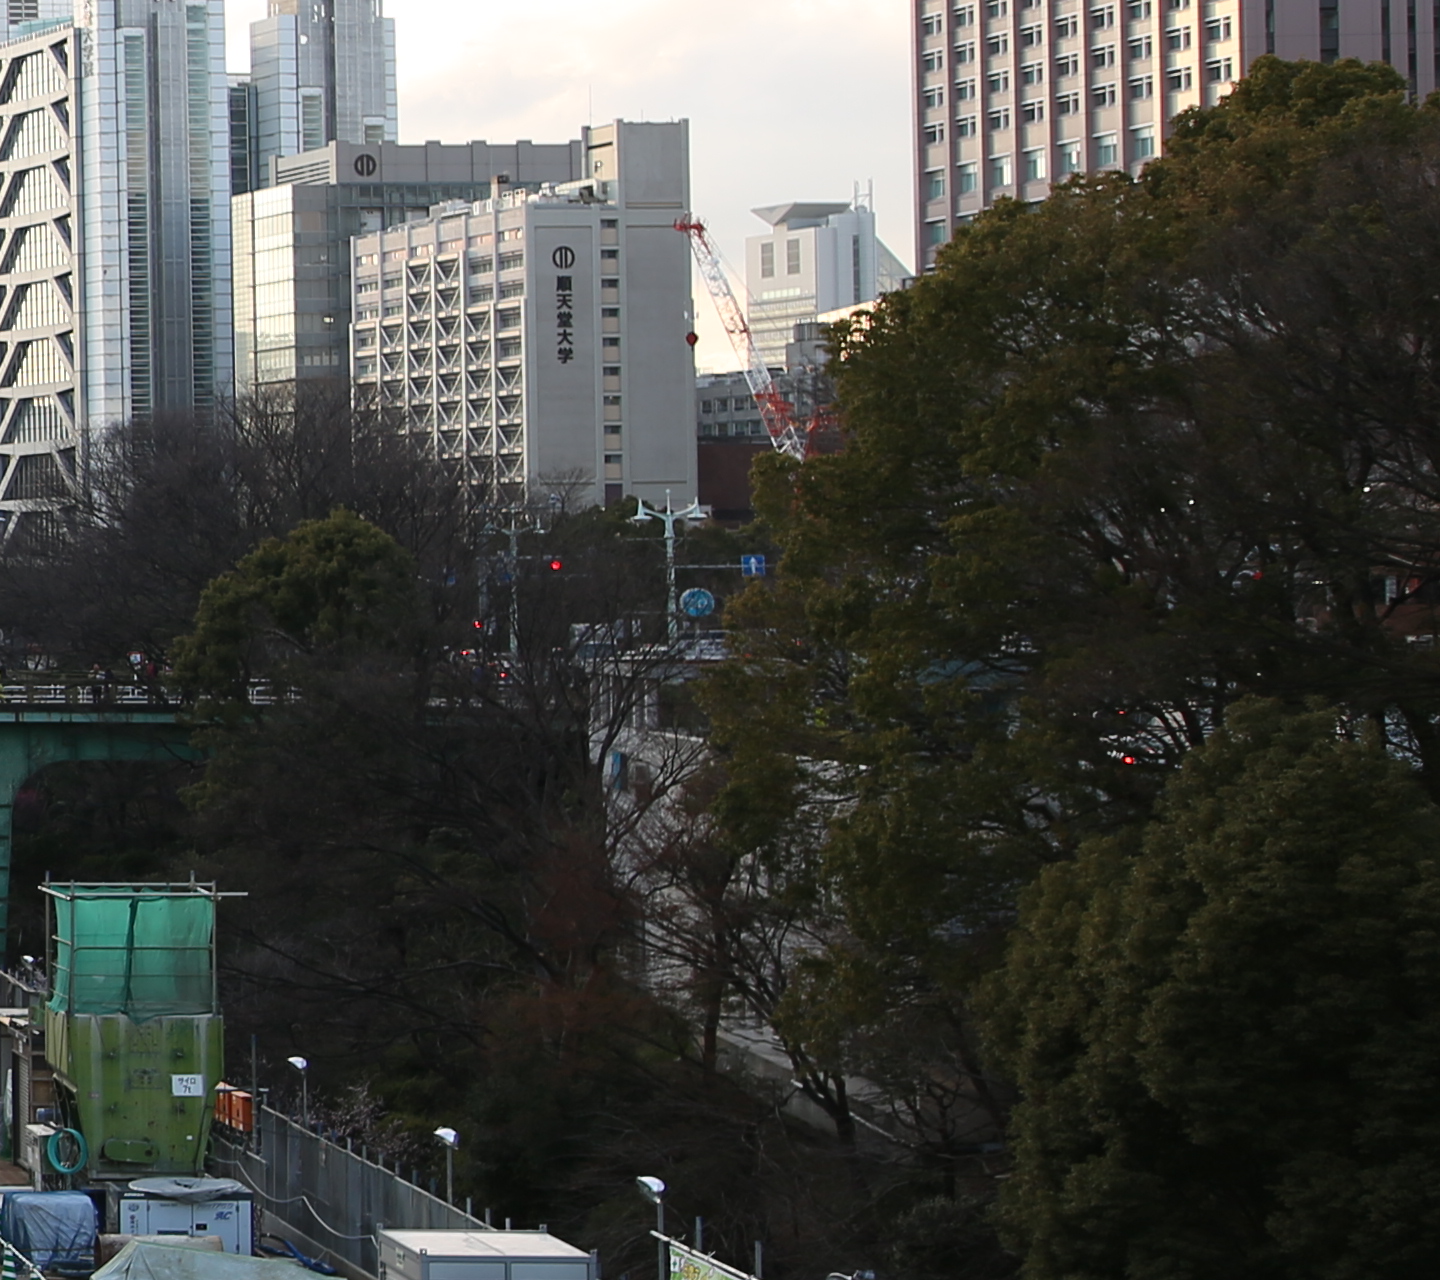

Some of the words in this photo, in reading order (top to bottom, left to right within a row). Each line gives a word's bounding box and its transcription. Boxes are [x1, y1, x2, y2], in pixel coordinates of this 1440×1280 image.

[556, 275, 574, 365] 順天堂大学
